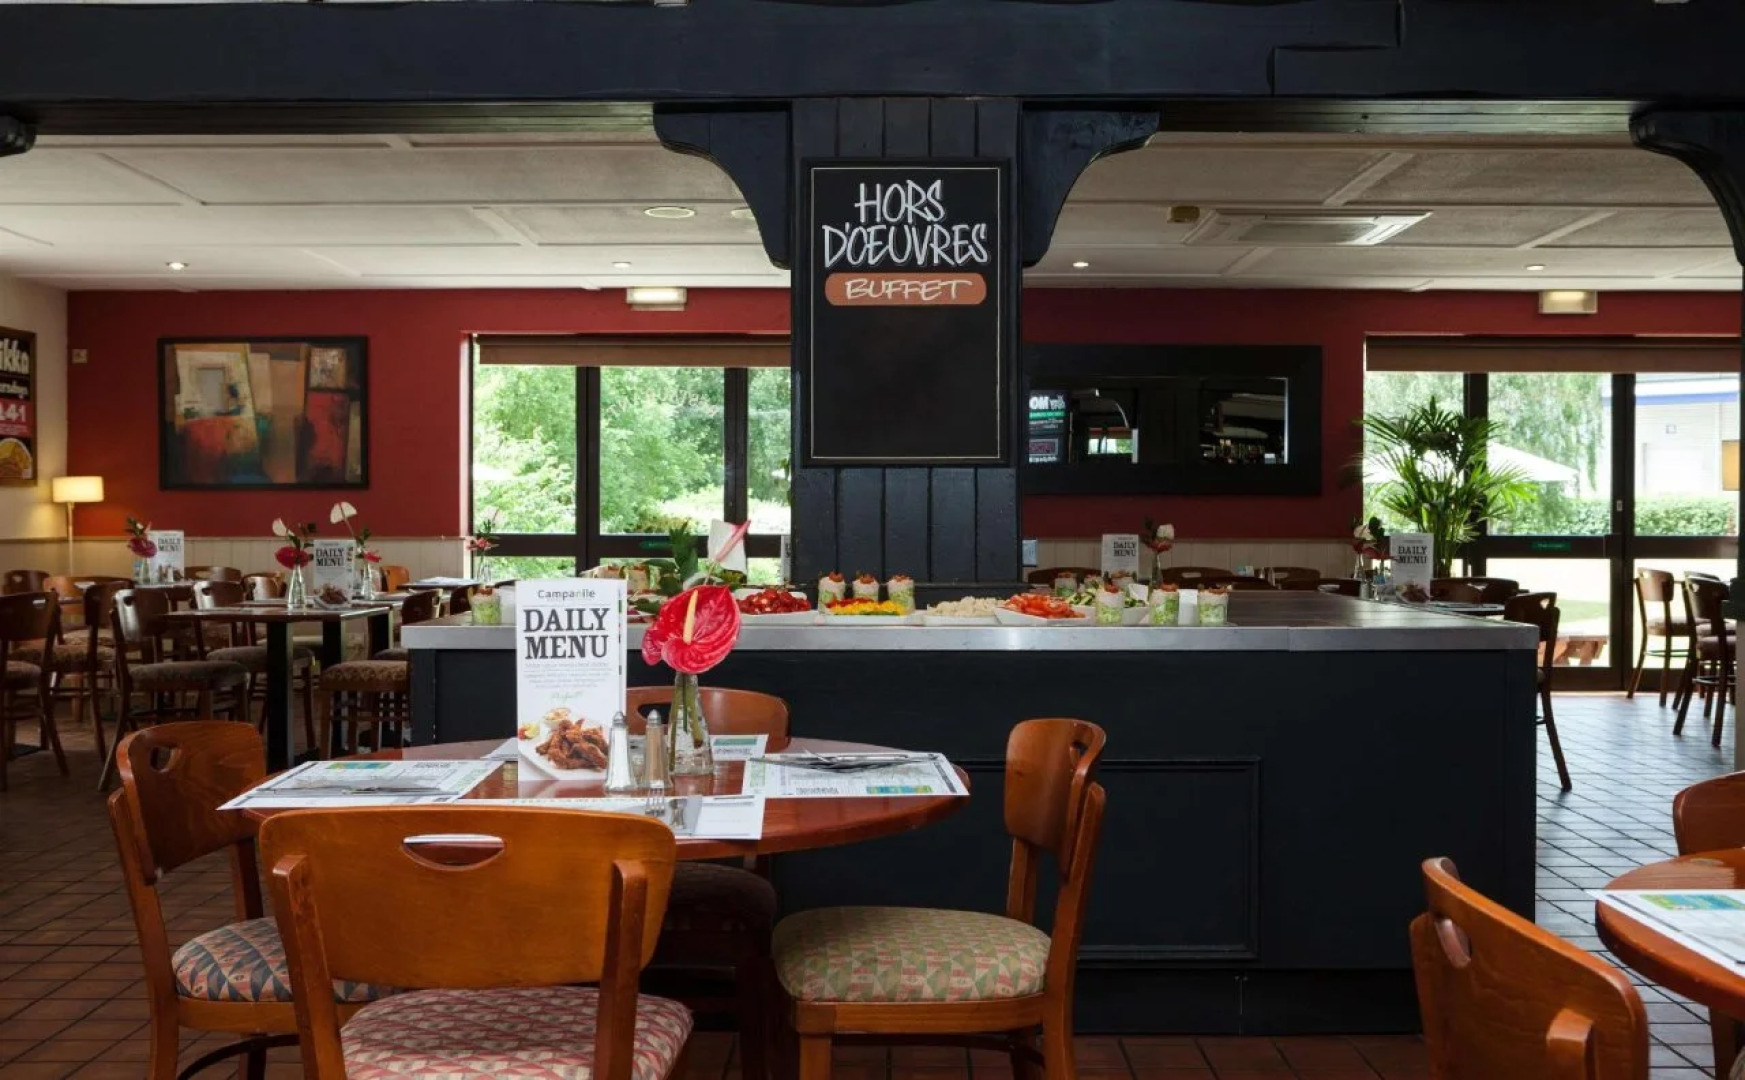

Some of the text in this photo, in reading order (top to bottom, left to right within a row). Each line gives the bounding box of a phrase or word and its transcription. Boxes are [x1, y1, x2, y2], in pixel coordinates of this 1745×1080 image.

[855, 180, 946, 224] HORS
[822, 222, 989, 268] D'OEUVRES
[844, 277, 973, 302] BUFFET
[1112, 541, 1136, 549] DAILY
[1398, 545, 1427, 555] DAILY
[315, 547, 344, 558] DAILY
[1113, 549, 1136, 557] MENU
[315, 558, 344, 567] MENU
[1397, 555, 1427, 564] MENU
[537, 589, 596, 601] Campanile
[523, 607, 611, 633] DAILY
[524, 634, 610, 660] MENU
